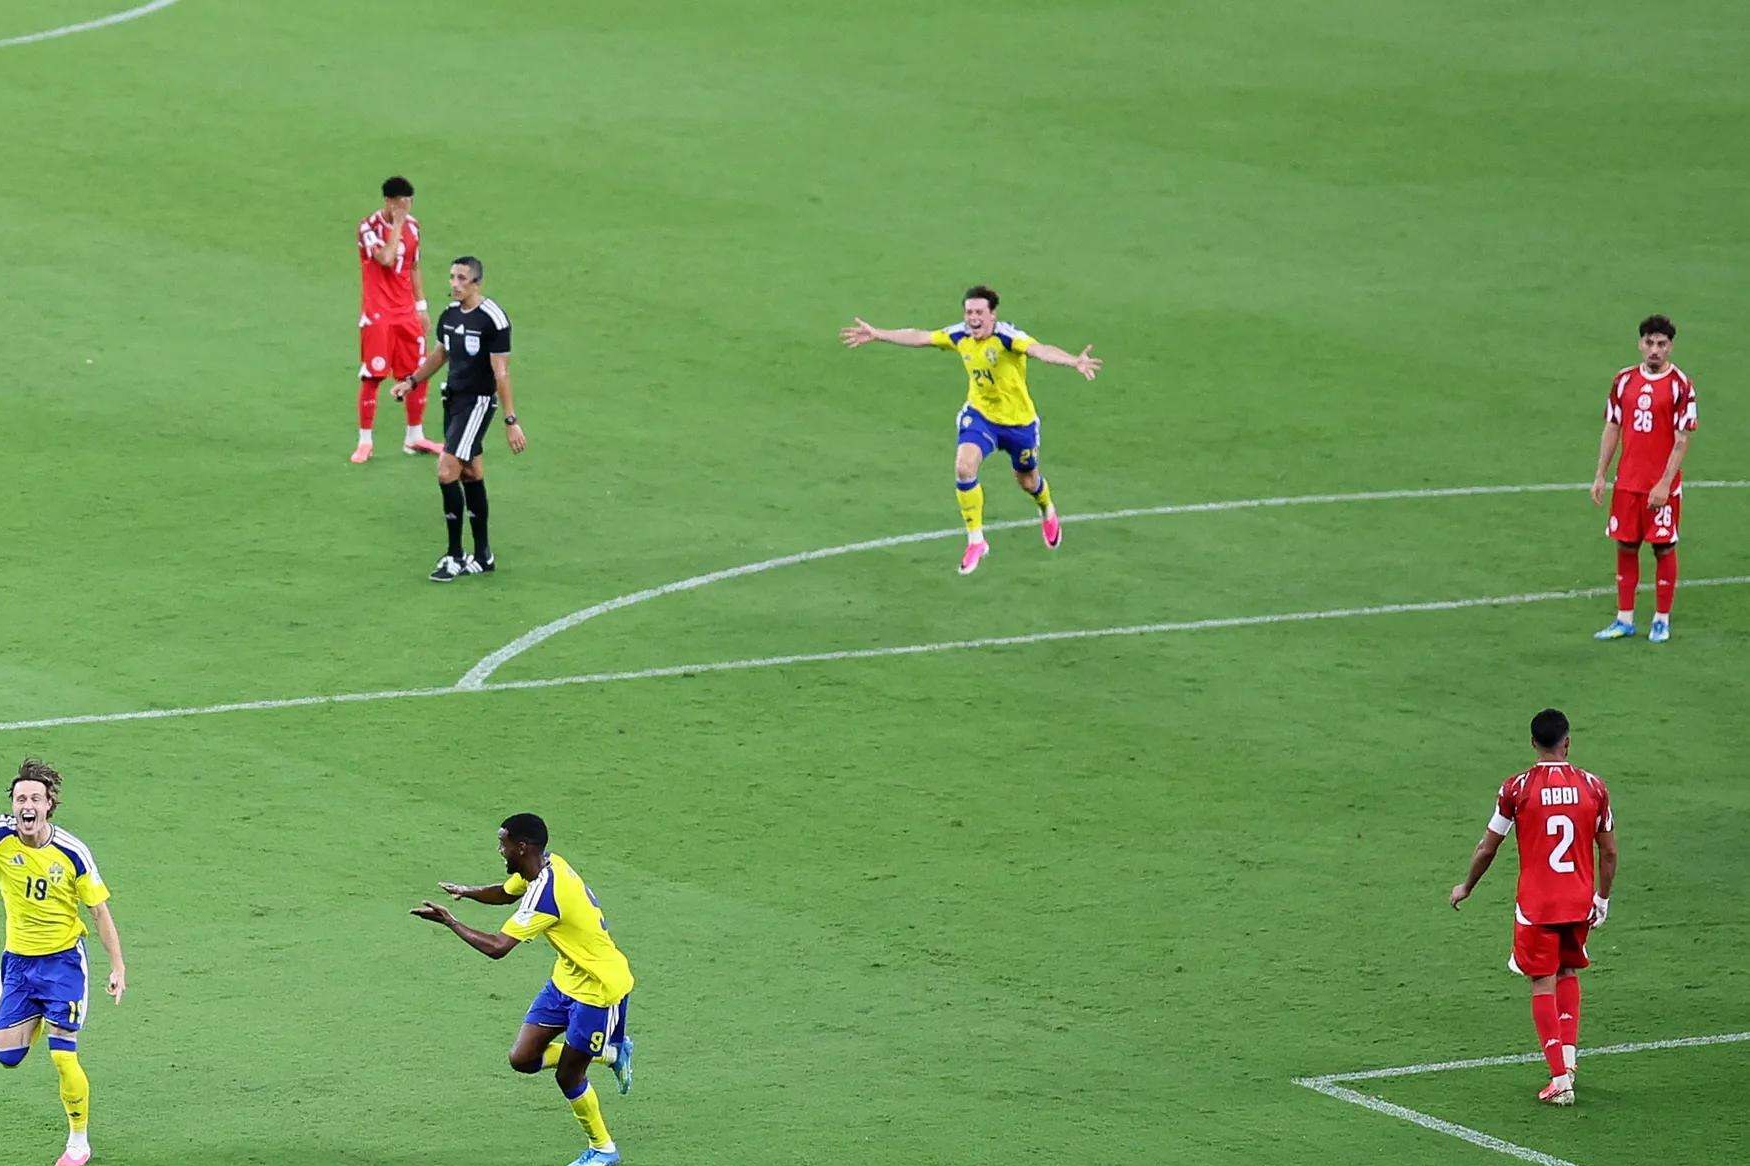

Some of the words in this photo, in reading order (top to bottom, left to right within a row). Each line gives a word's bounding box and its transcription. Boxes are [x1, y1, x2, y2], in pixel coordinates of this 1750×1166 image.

[972, 369, 995, 387] 24
[1633, 408, 1654, 433] 26
[1653, 505, 1672, 528] 26
[1541, 786, 1580, 806] ABDI
[1546, 813, 1576, 874] 2
[25, 876, 49, 902] 19
[589, 1031, 605, 1053] 9
